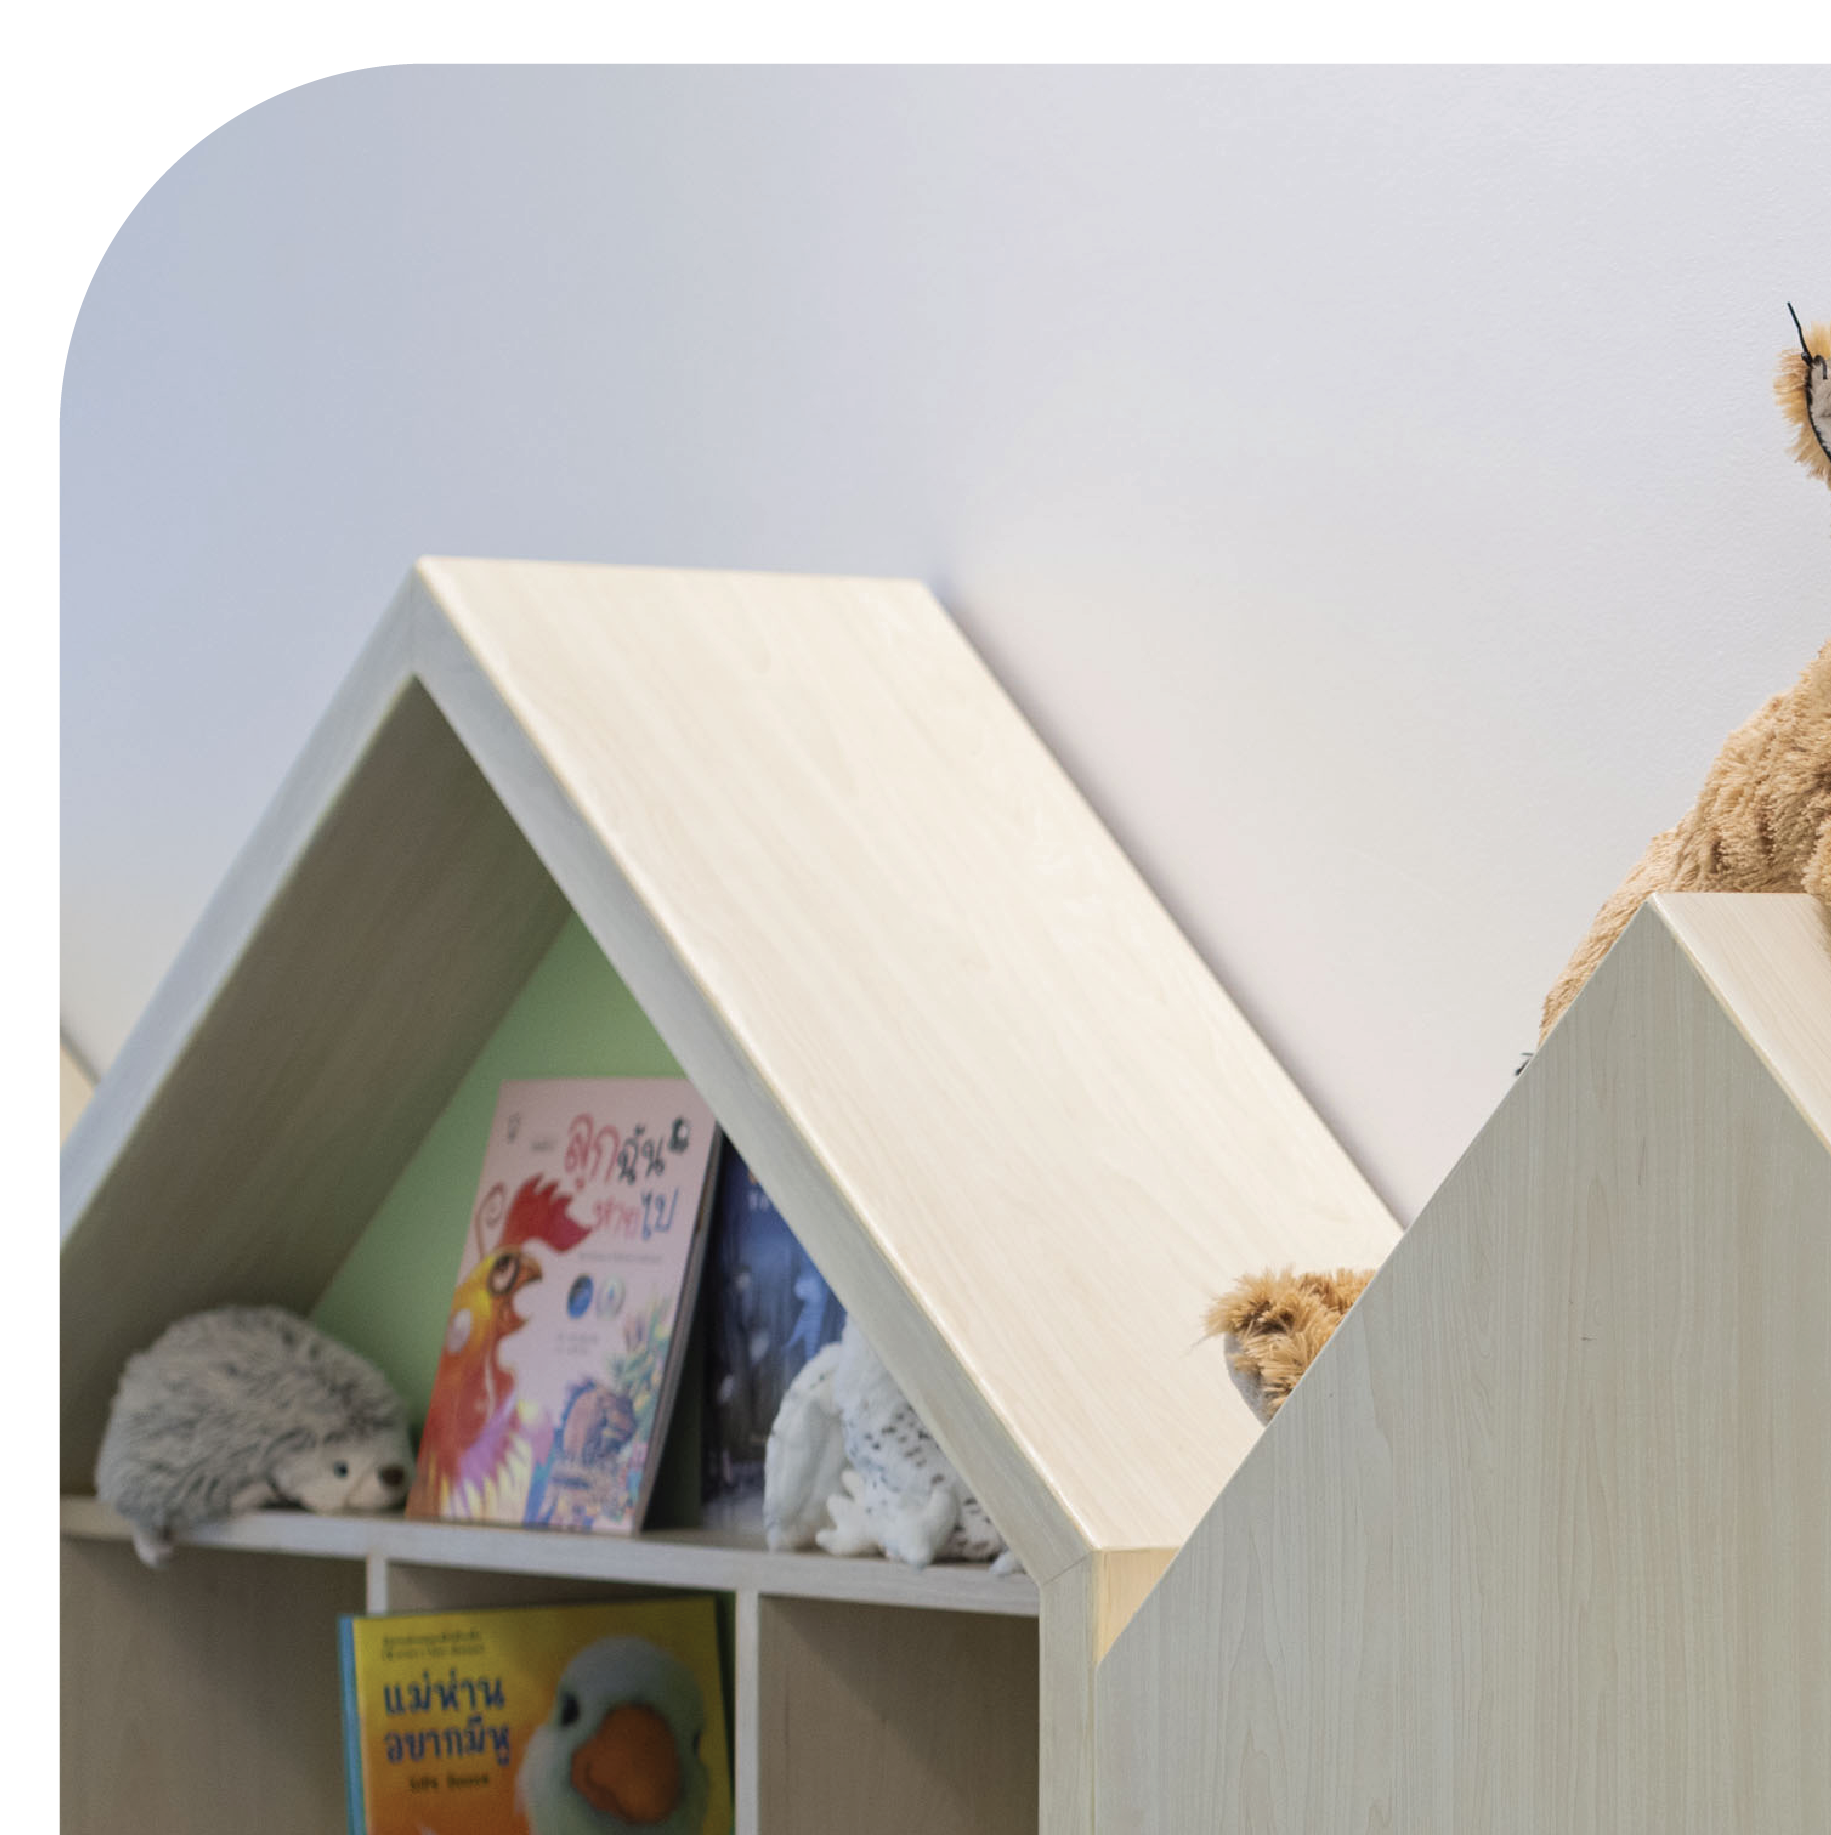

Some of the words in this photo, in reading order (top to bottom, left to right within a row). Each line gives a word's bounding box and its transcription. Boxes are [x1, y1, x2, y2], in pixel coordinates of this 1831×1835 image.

[384, 1667, 506, 1715] แม่ห่าน
[384, 1711, 512, 1767] อยากมีหู
